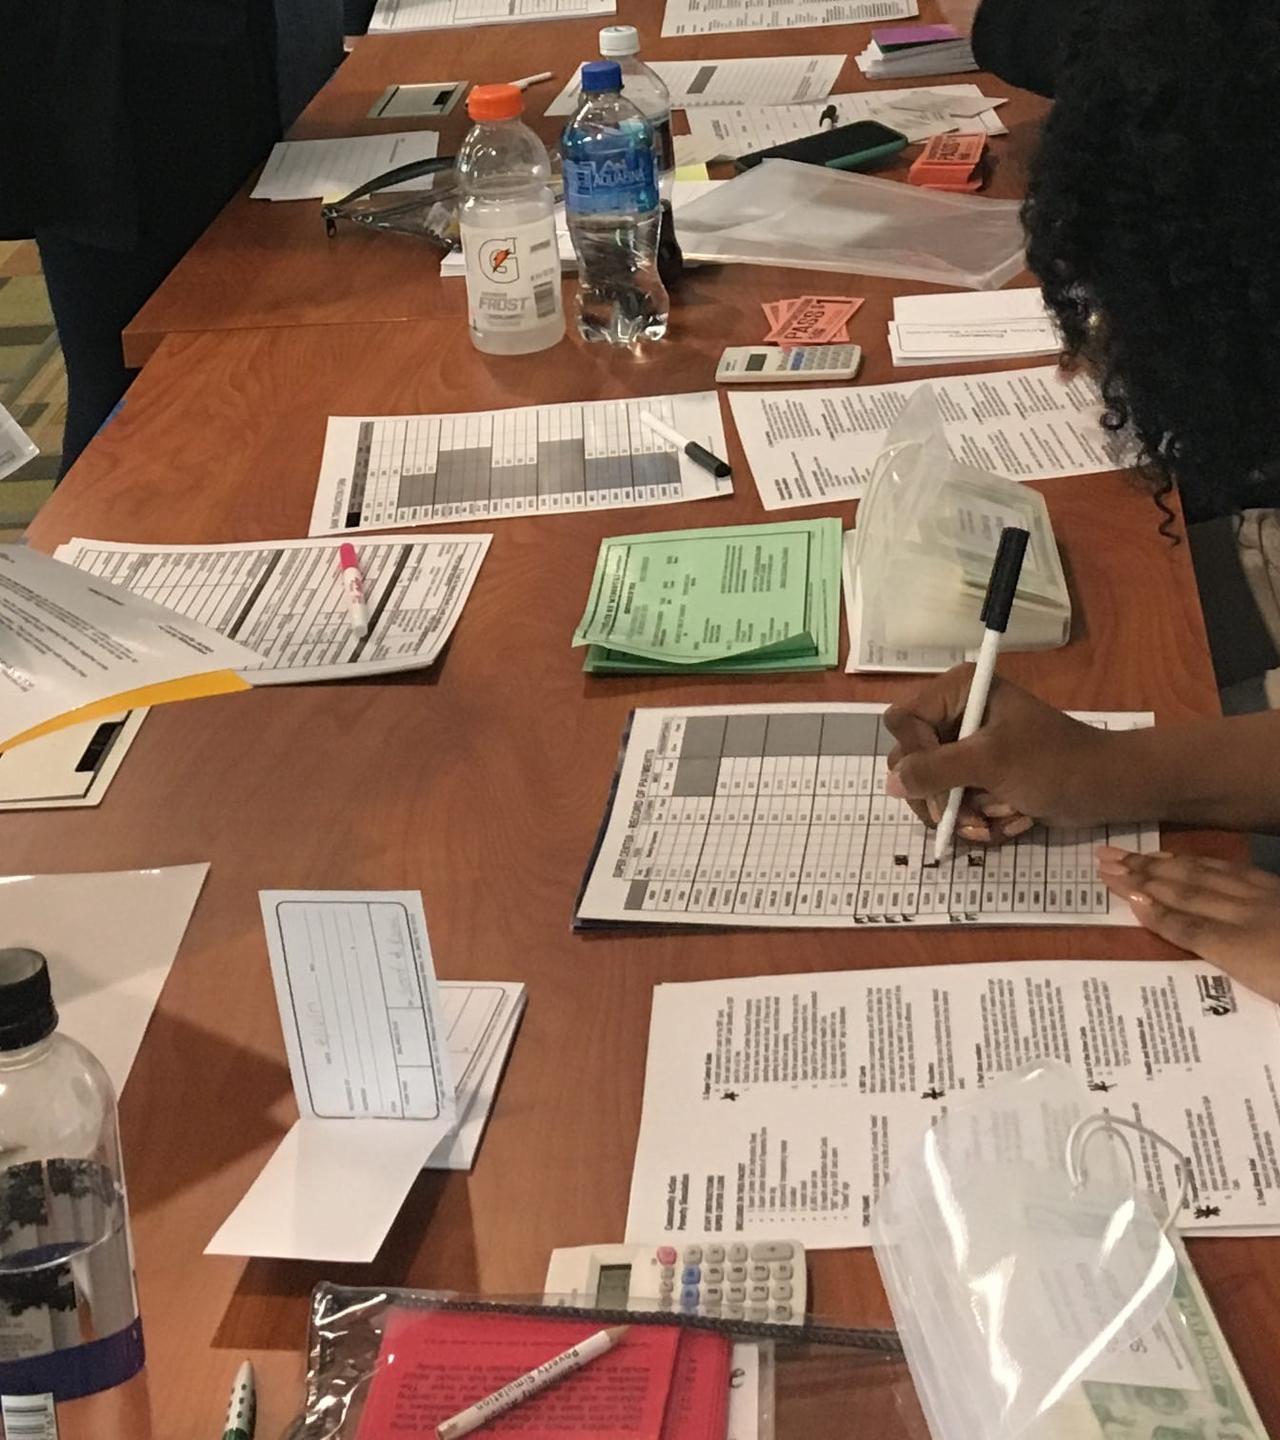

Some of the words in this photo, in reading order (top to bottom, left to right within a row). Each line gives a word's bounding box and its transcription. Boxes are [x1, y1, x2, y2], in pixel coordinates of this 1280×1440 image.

[478, 236, 519, 284] G
[478, 296, 531, 312] FROST
[618, 832, 634, 859] CENTER
[627, 798, 644, 829] RECORD
[636, 747, 656, 788] PAYMENTS
[535, 1345, 580, 1379] Poverty
[474, 1369, 536, 1416] Simulation
